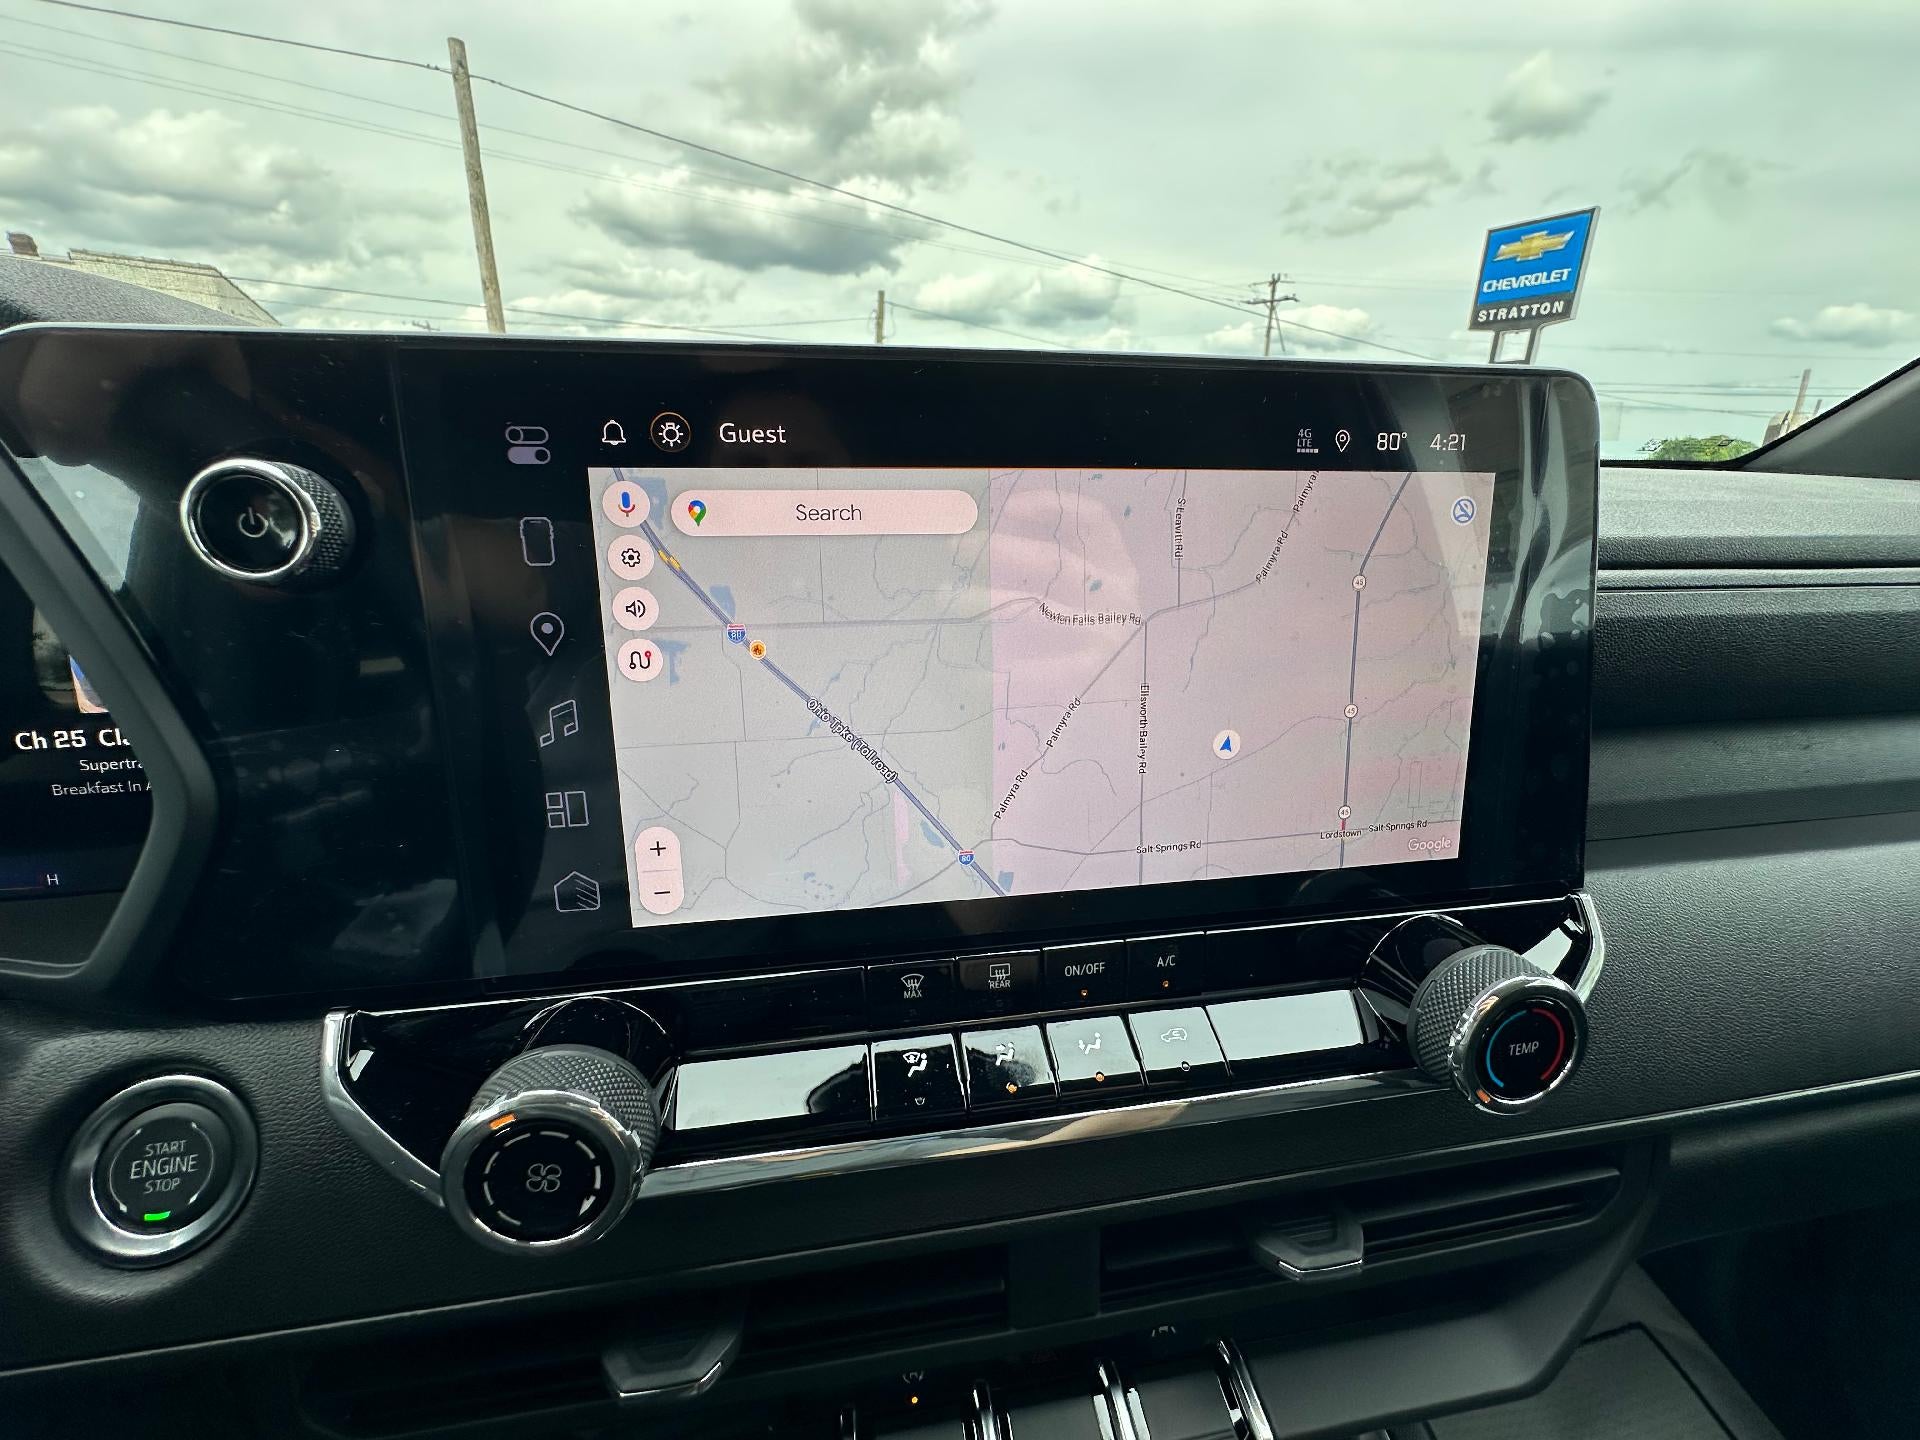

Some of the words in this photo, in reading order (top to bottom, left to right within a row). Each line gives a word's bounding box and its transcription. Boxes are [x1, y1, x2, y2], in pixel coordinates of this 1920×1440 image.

[1483, 268, 1572, 293] CHEVROLET
[1478, 300, 1564, 322] STRATTON
[719, 422, 787, 443] Guest
[1298, 428, 1312, 438] 4G
[1376, 431, 1408, 451] 80°
[1297, 438, 1313, 448] LTE
[1430, 433, 1466, 451] 4:21
[1293, 473, 1318, 513] Palmyra
[796, 503, 862, 521] Search
[1174, 544, 1184, 560] Rd
[1255, 546, 1281, 584] Palmyra
[1276, 530, 1289, 547] Rd
[1072, 614, 1096, 626] Falls
[1098, 611, 1127, 626] Bailey
[1139, 685, 1149, 729] Ellsworth
[1046, 709, 1072, 748] Palmyra
[1068, 697, 1081, 712] Rd
[15, 731, 48, 750] Ch
[53, 729, 87, 749] 25
[806, 699, 831, 722] Ohio
[830, 716, 855, 742] Tpke
[850, 737, 878, 761] (Toll
[870, 757, 899, 784] road)
[1137, 730, 1148, 760] Bailey
[1138, 761, 1147, 774] Rd
[51, 781, 125, 796] Breakfast
[128, 780, 142, 793] In
[994, 783, 1020, 820] Palmyra
[1015, 769, 1029, 784] Rd
[1320, 830, 1362, 840] Lordstown
[1368, 824, 1384, 833] Salt
[1385, 822, 1415, 832] Springs
[1416, 820, 1428, 829] Rd
[1136, 845, 1153, 854] Salt
[1155, 843, 1188, 854] Springs
[1189, 840, 1202, 849] Rd
[1408, 836, 1452, 852] Google
[46, 873, 59, 886] H
[1064, 962, 1106, 977] ON/OFF
[1157, 954, 1176, 968] A/C
[990, 979, 1011, 989] REAR
[903, 989, 922, 999] MAX
[1510, 1041, 1539, 1056] TEMP
[144, 1140, 186, 1157] START
[130, 1154, 199, 1179] ENGINE
[144, 1177, 180, 1194] STOP
